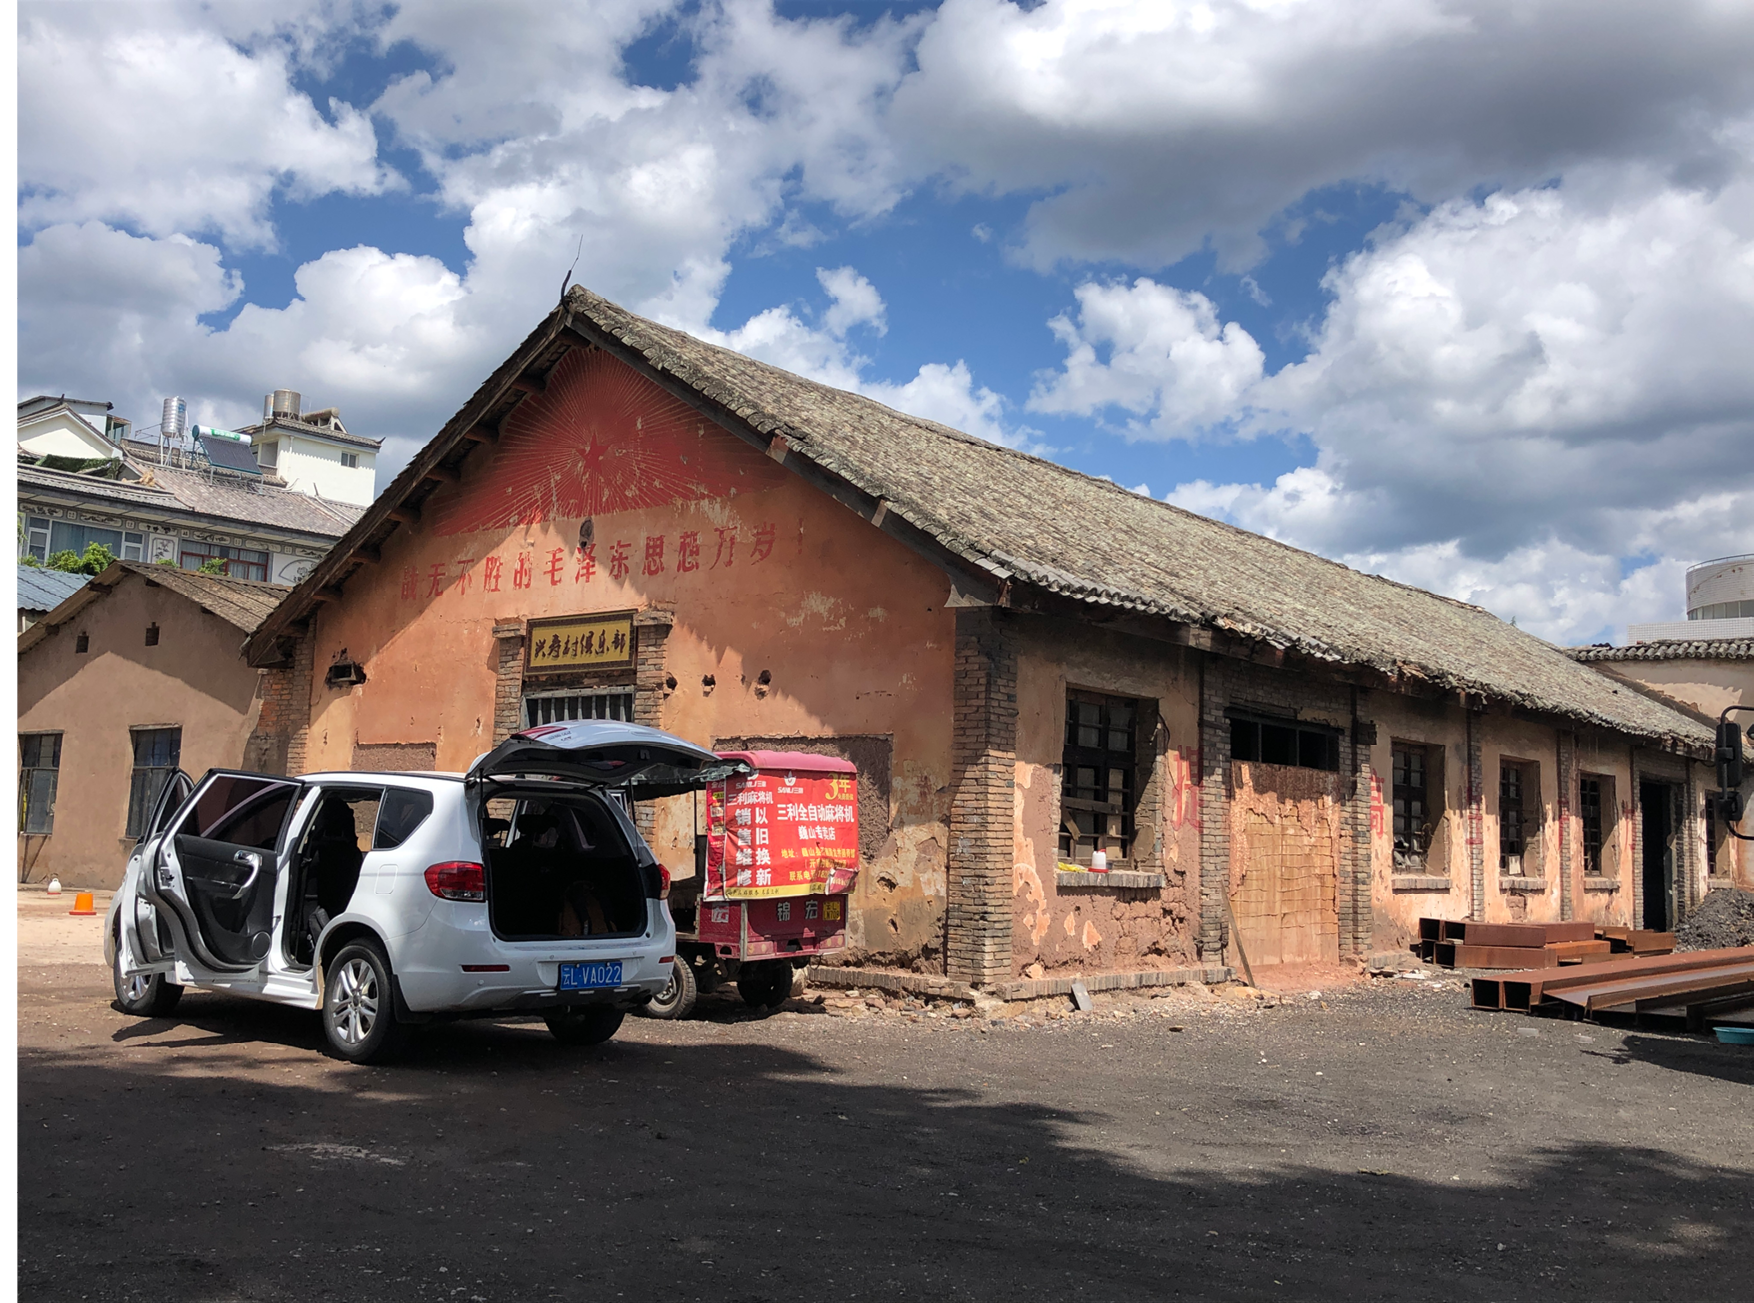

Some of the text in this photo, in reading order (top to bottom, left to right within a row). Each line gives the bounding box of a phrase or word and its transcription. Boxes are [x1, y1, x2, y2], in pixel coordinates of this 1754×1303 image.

[727, 791, 774, 806] 三利麻将机
[777, 803, 855, 823] 三利全自动麻将机
